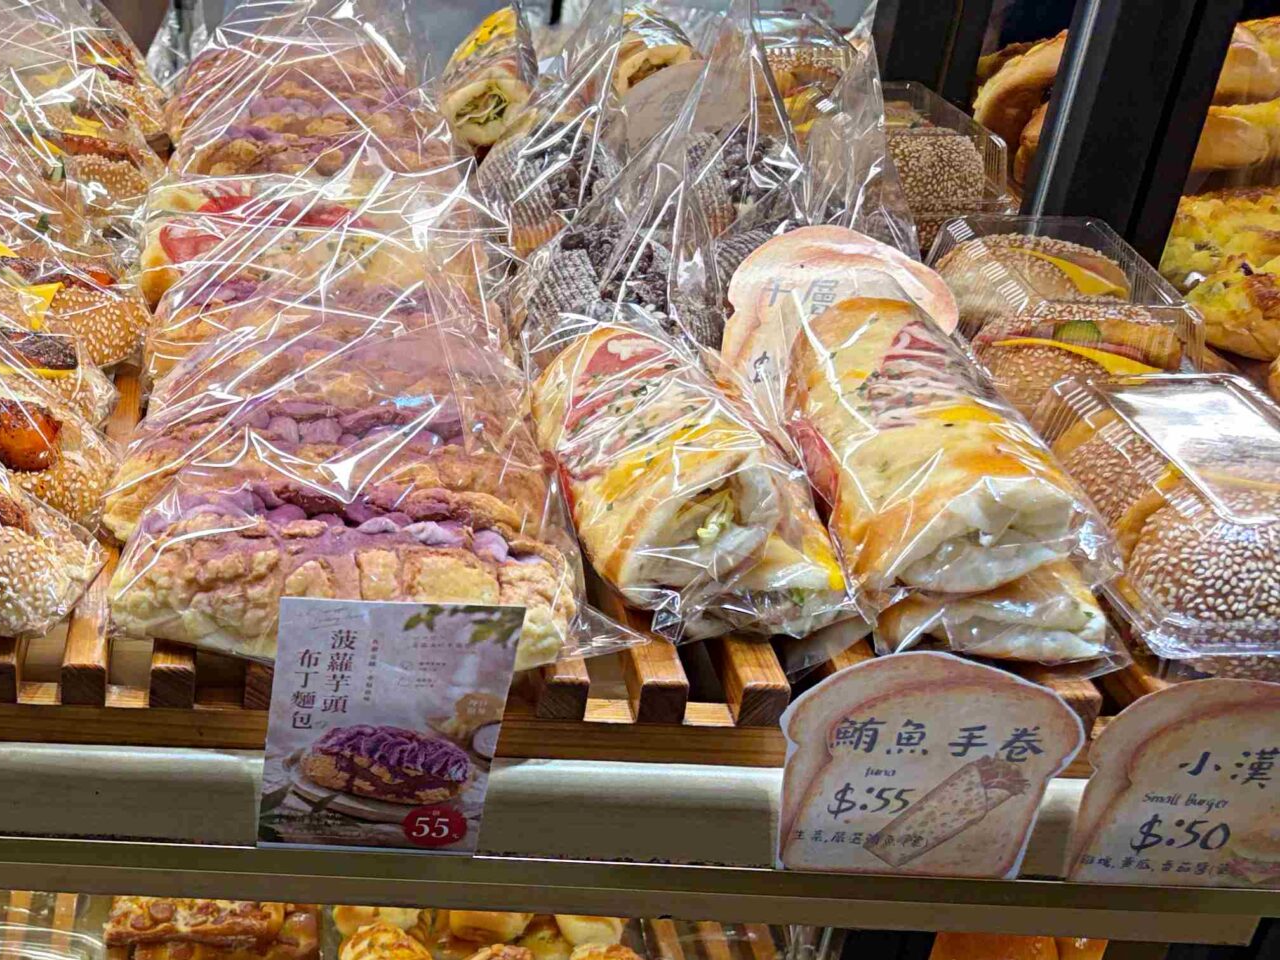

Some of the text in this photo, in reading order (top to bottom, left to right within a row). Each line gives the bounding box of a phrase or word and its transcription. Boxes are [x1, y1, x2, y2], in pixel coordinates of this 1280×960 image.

[291, 649, 322, 731] 布丁麵包
[322, 628, 357, 714] 菠蘿芋頭
[829, 717, 1044, 762] 鮪魚手卷
[827, 783, 915, 820] $:55
[412, 817, 450, 838] 55
[1130, 813, 1231, 855] $:50
